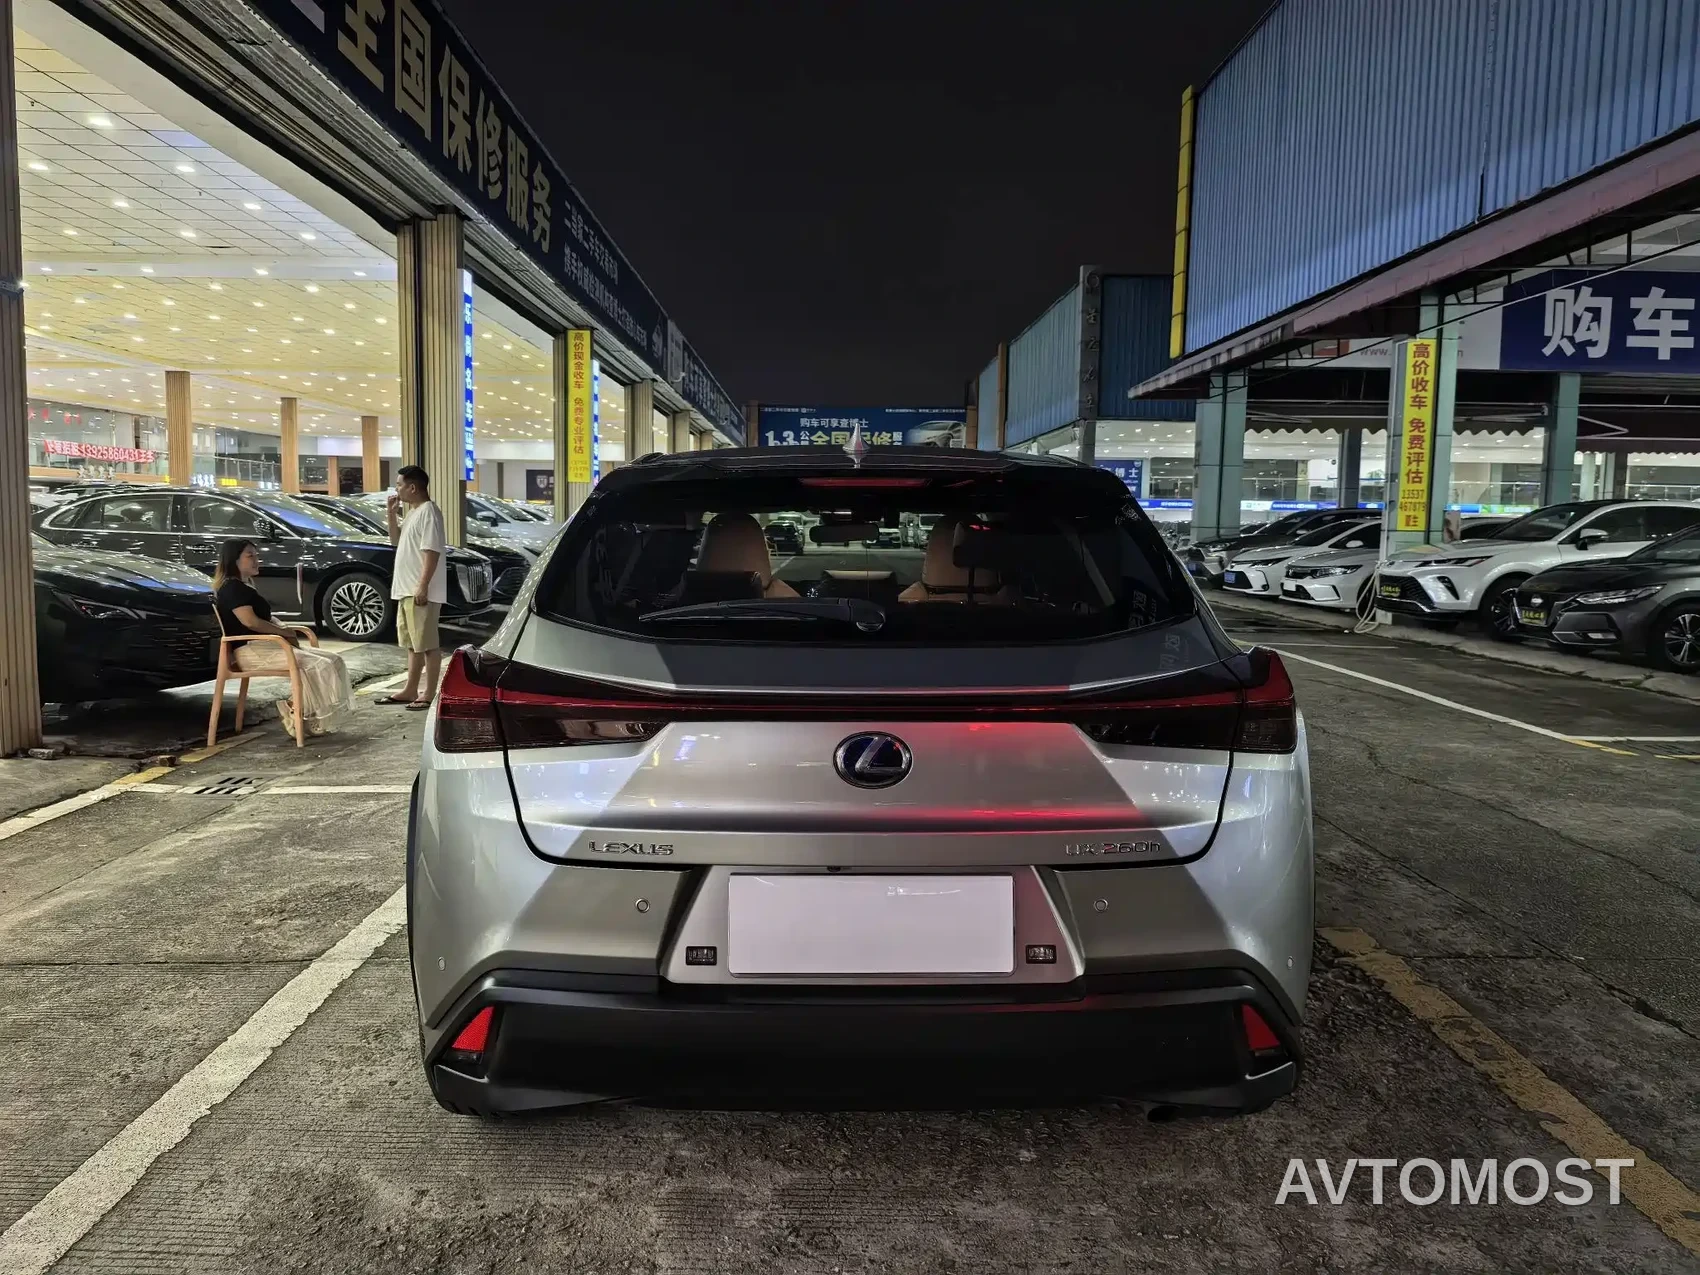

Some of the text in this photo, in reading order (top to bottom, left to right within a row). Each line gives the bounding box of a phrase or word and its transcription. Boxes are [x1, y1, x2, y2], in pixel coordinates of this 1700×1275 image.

[1541, 286, 1696, 361] 购车
[573, 332, 585, 389] 高价现金收车
[573, 398, 585, 455] 免费专业评估
[1405, 343, 1430, 484] 高价收车 免费评估
[588, 840, 674, 856] LEXUS
[1064, 841, 1160, 856] UX 260h
